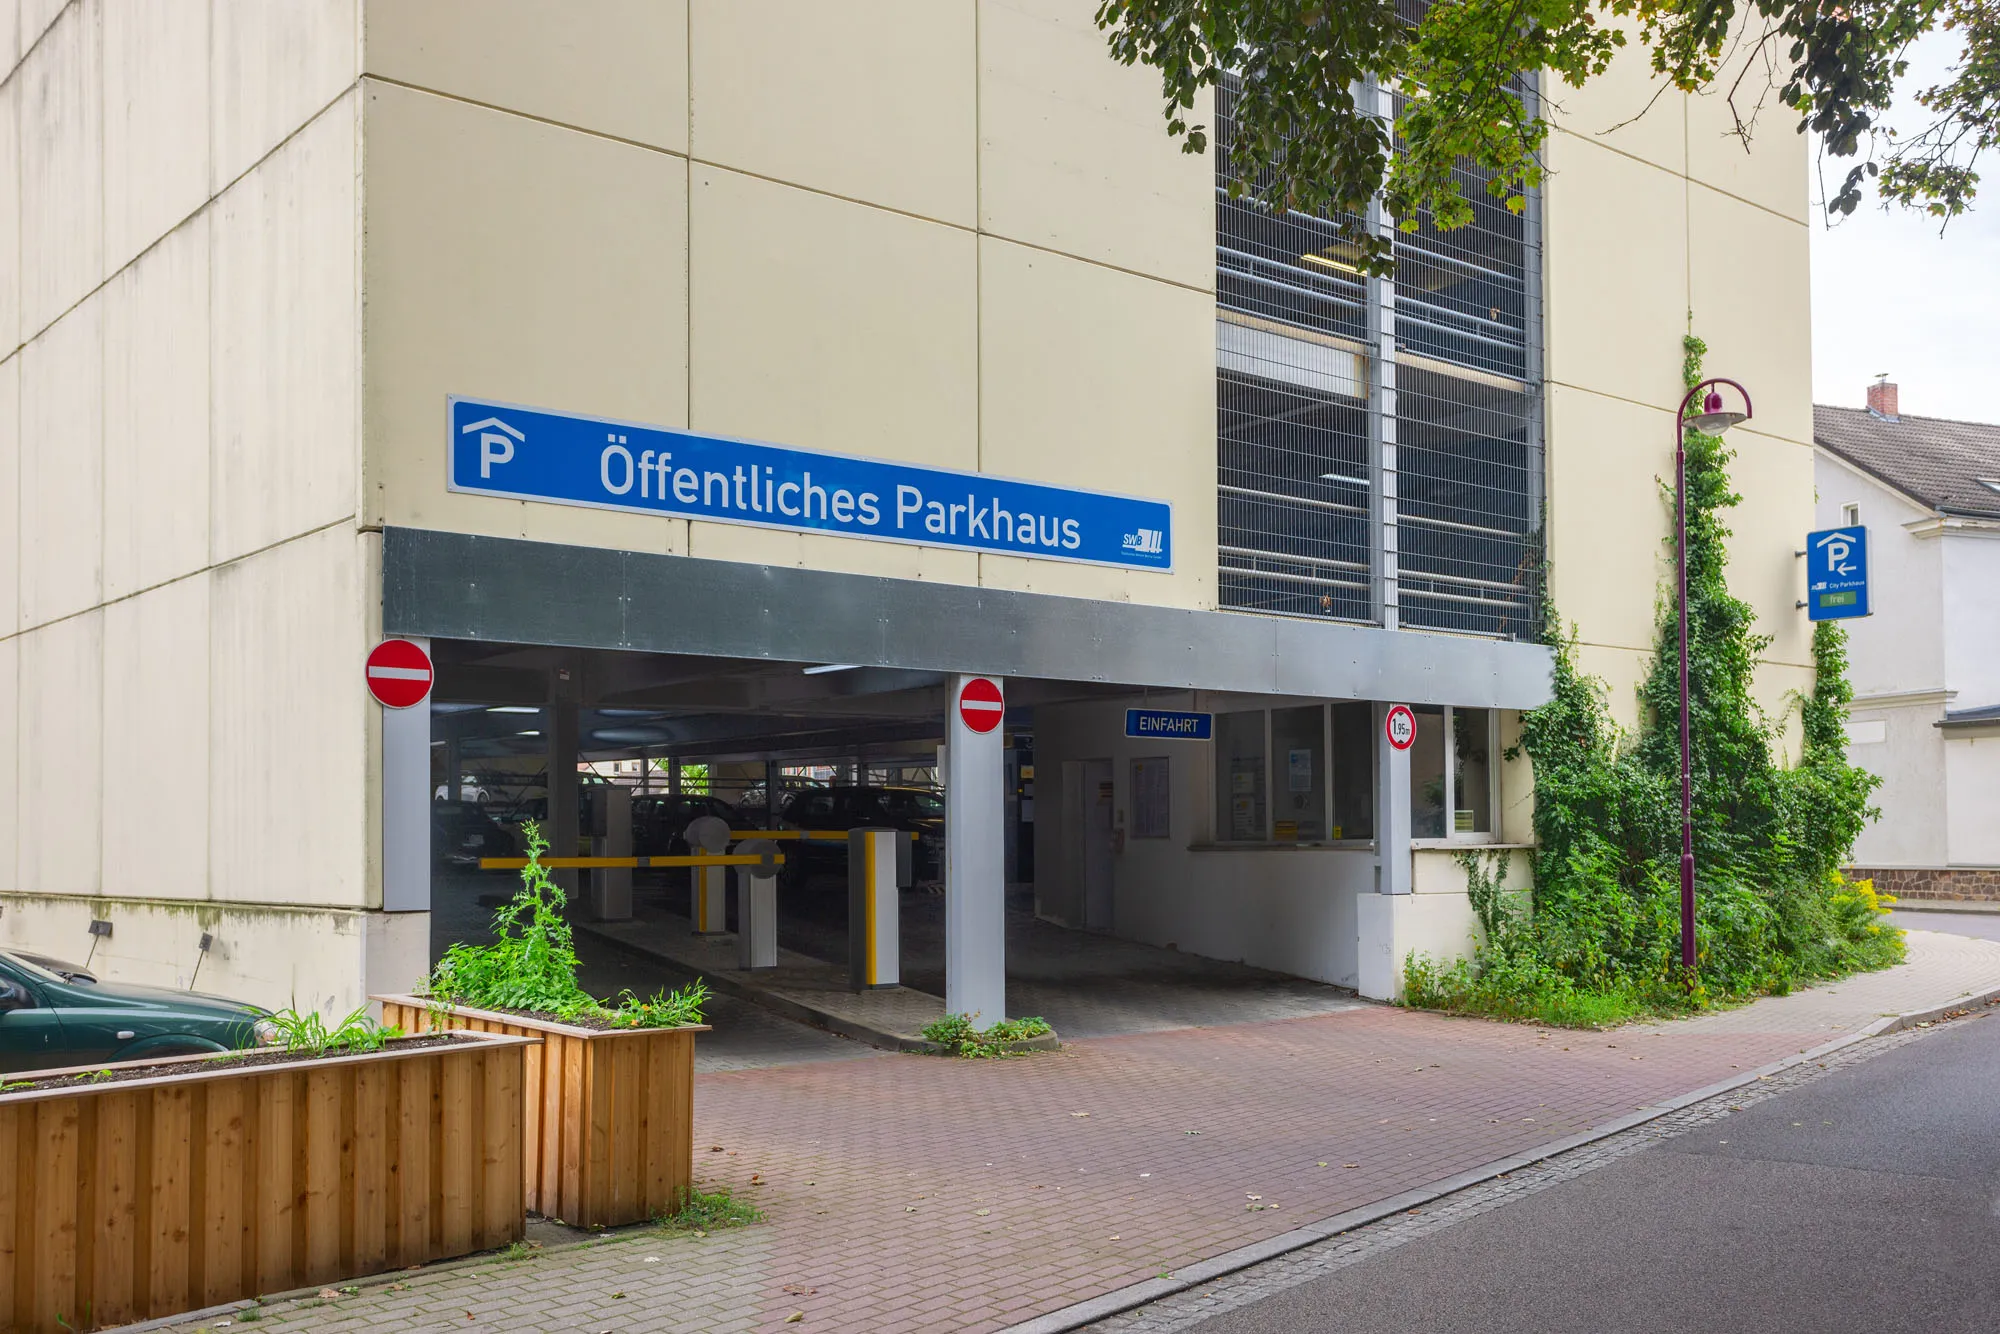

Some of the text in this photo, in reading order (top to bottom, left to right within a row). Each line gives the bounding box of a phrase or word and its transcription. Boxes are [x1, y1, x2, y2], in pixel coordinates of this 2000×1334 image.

[481, 431, 515, 479] P
[600, 433, 1081, 550] Öffentliches Parkhaus
[1828, 542, 1850, 571] P
[1140, 716, 1199, 733] EINFAHRT
